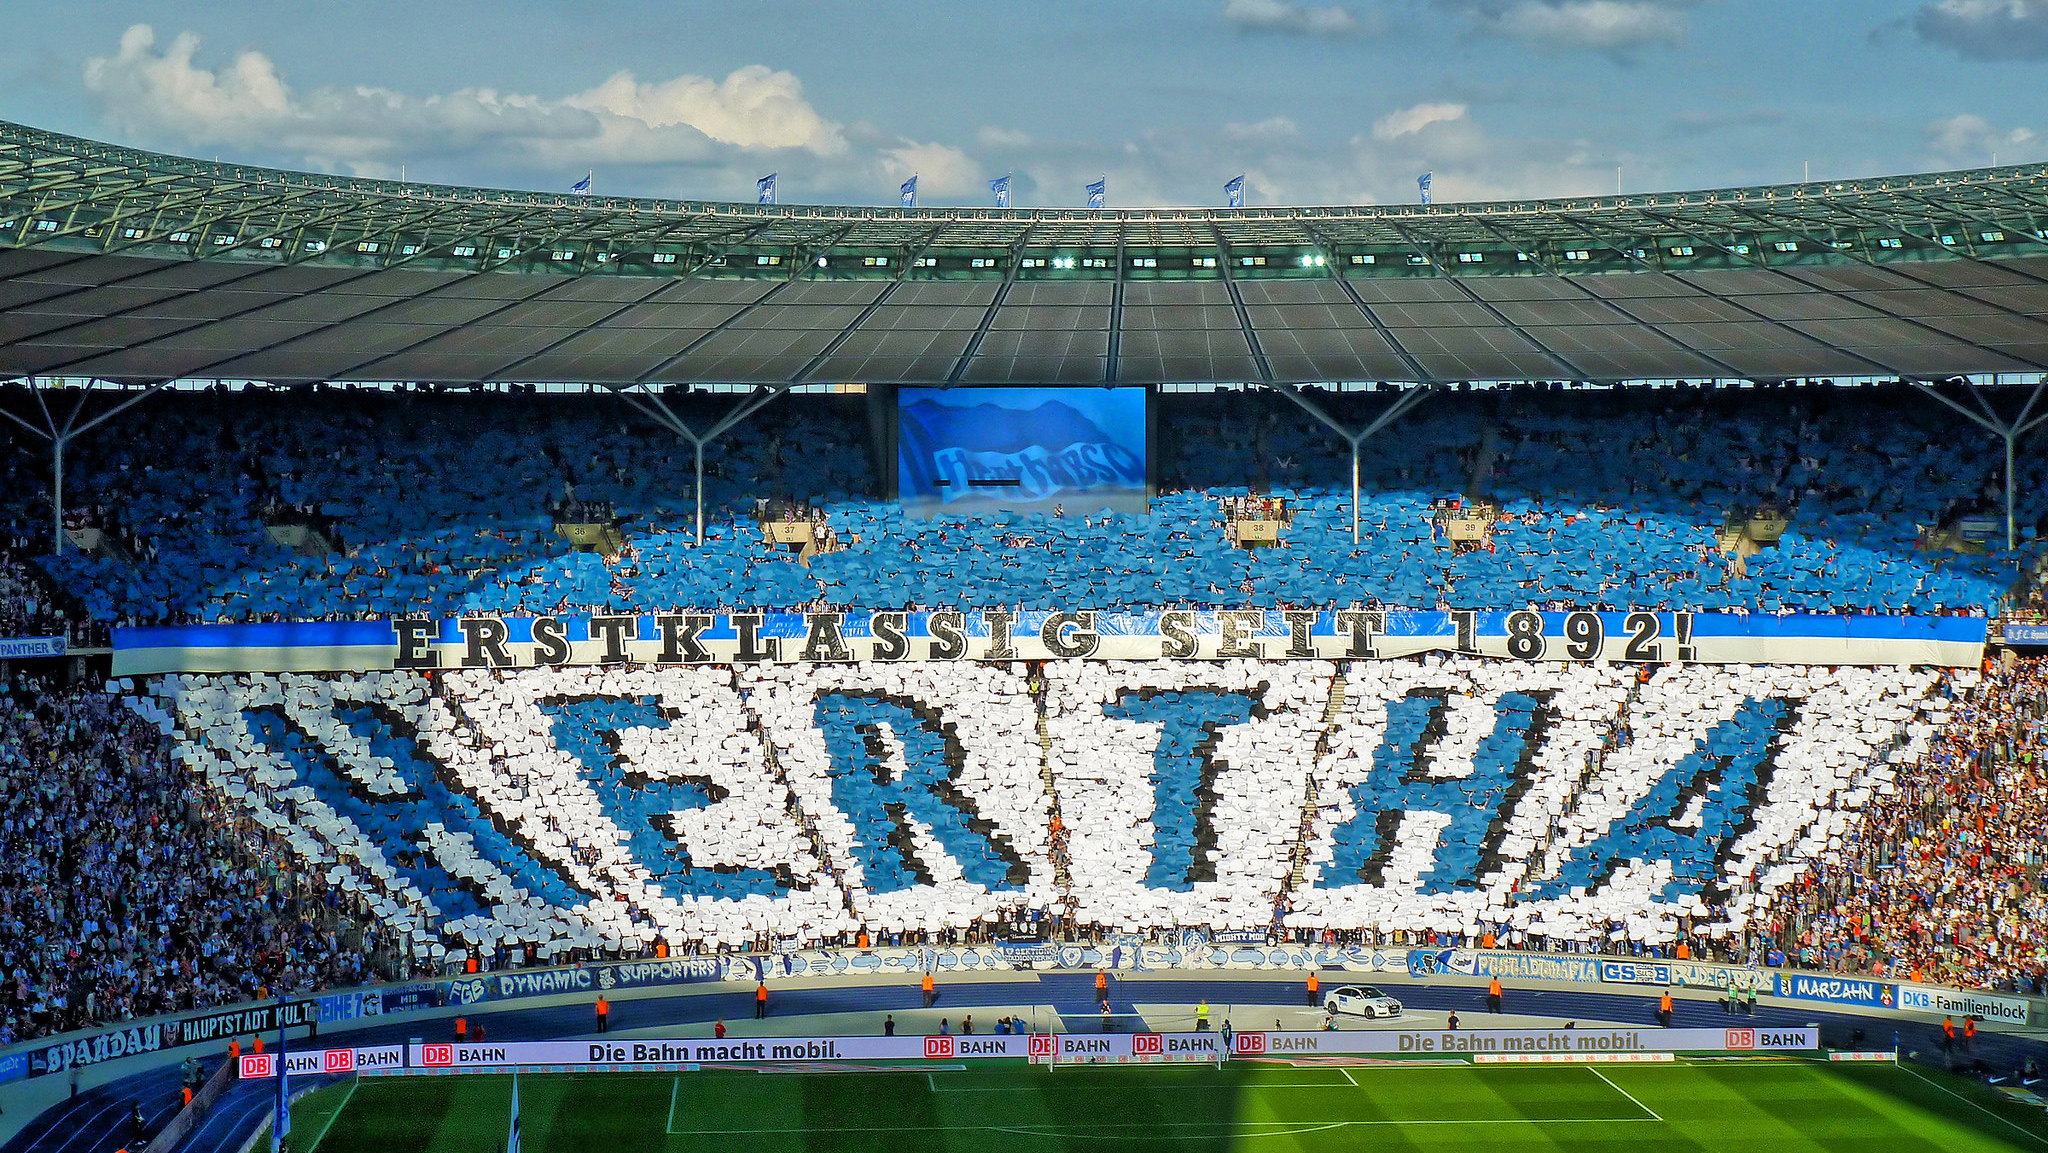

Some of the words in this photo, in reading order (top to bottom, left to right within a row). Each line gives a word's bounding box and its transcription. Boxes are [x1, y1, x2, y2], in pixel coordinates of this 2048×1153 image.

[783, 526, 795, 534] 37
[1253, 524, 1264, 532] 38
[1464, 524, 1475, 532] 39
[1763, 523, 1774, 531] 40
[392, 611, 1097, 668] ERSTKLASSIG
[1158, 609, 1387, 661] SEIT
[1448, 610, 1698, 662] 1892!
[0, 642, 49, 656] PANTHER
[240, 686, 1800, 921] HERTHA
[1214, 932, 1248, 942] MIGHTY
[1248, 932, 1266, 941] MOB
[501, 970, 591, 996] DYNAMIC
[618, 959, 717, 984] SUPPORTERS
[1671, 964, 1716, 986] RUDE
[448, 979, 485, 1005] FGB
[1796, 978, 1874, 1000] MARZAHN
[354, 992, 363, 1018] 7
[1903, 991, 2026, 1019] DKB-Familienblock
[183, 1009, 270, 1042] HAUPTSTADT
[275, 1002, 311, 1027] KULT
[47, 1023, 161, 1073] SPANDAU
[926, 1038, 953, 1055] DB
[960, 1040, 1006, 1054] BAHN
[1064, 1039, 1110, 1053] BAHN
[1136, 1036, 1160, 1052] DB
[1168, 1037, 1214, 1052] BAHN
[1239, 1035, 1263, 1051] DB
[1271, 1037, 1318, 1050] BAHN
[1398, 1033, 1435, 1051] Die
[1441, 1033, 1496, 1051] Bahn
[1503, 1033, 1571, 1050] macht
[1577, 1031, 1645, 1050] mobil.
[1728, 1031, 1752, 1047] DB
[1760, 1033, 1806, 1046] BAHN
[327, 1051, 351, 1070] DB
[357, 1050, 400, 1067] BAHN
[424, 1046, 451, 1063] DB
[458, 1048, 506, 1062] BAHN
[588, 1044, 626, 1062] Die
[633, 1044, 689, 1061] Bahn
[697, 1042, 765, 1060] macht
[772, 1040, 842, 1059] mobil.
[244, 1057, 269, 1075] DB
